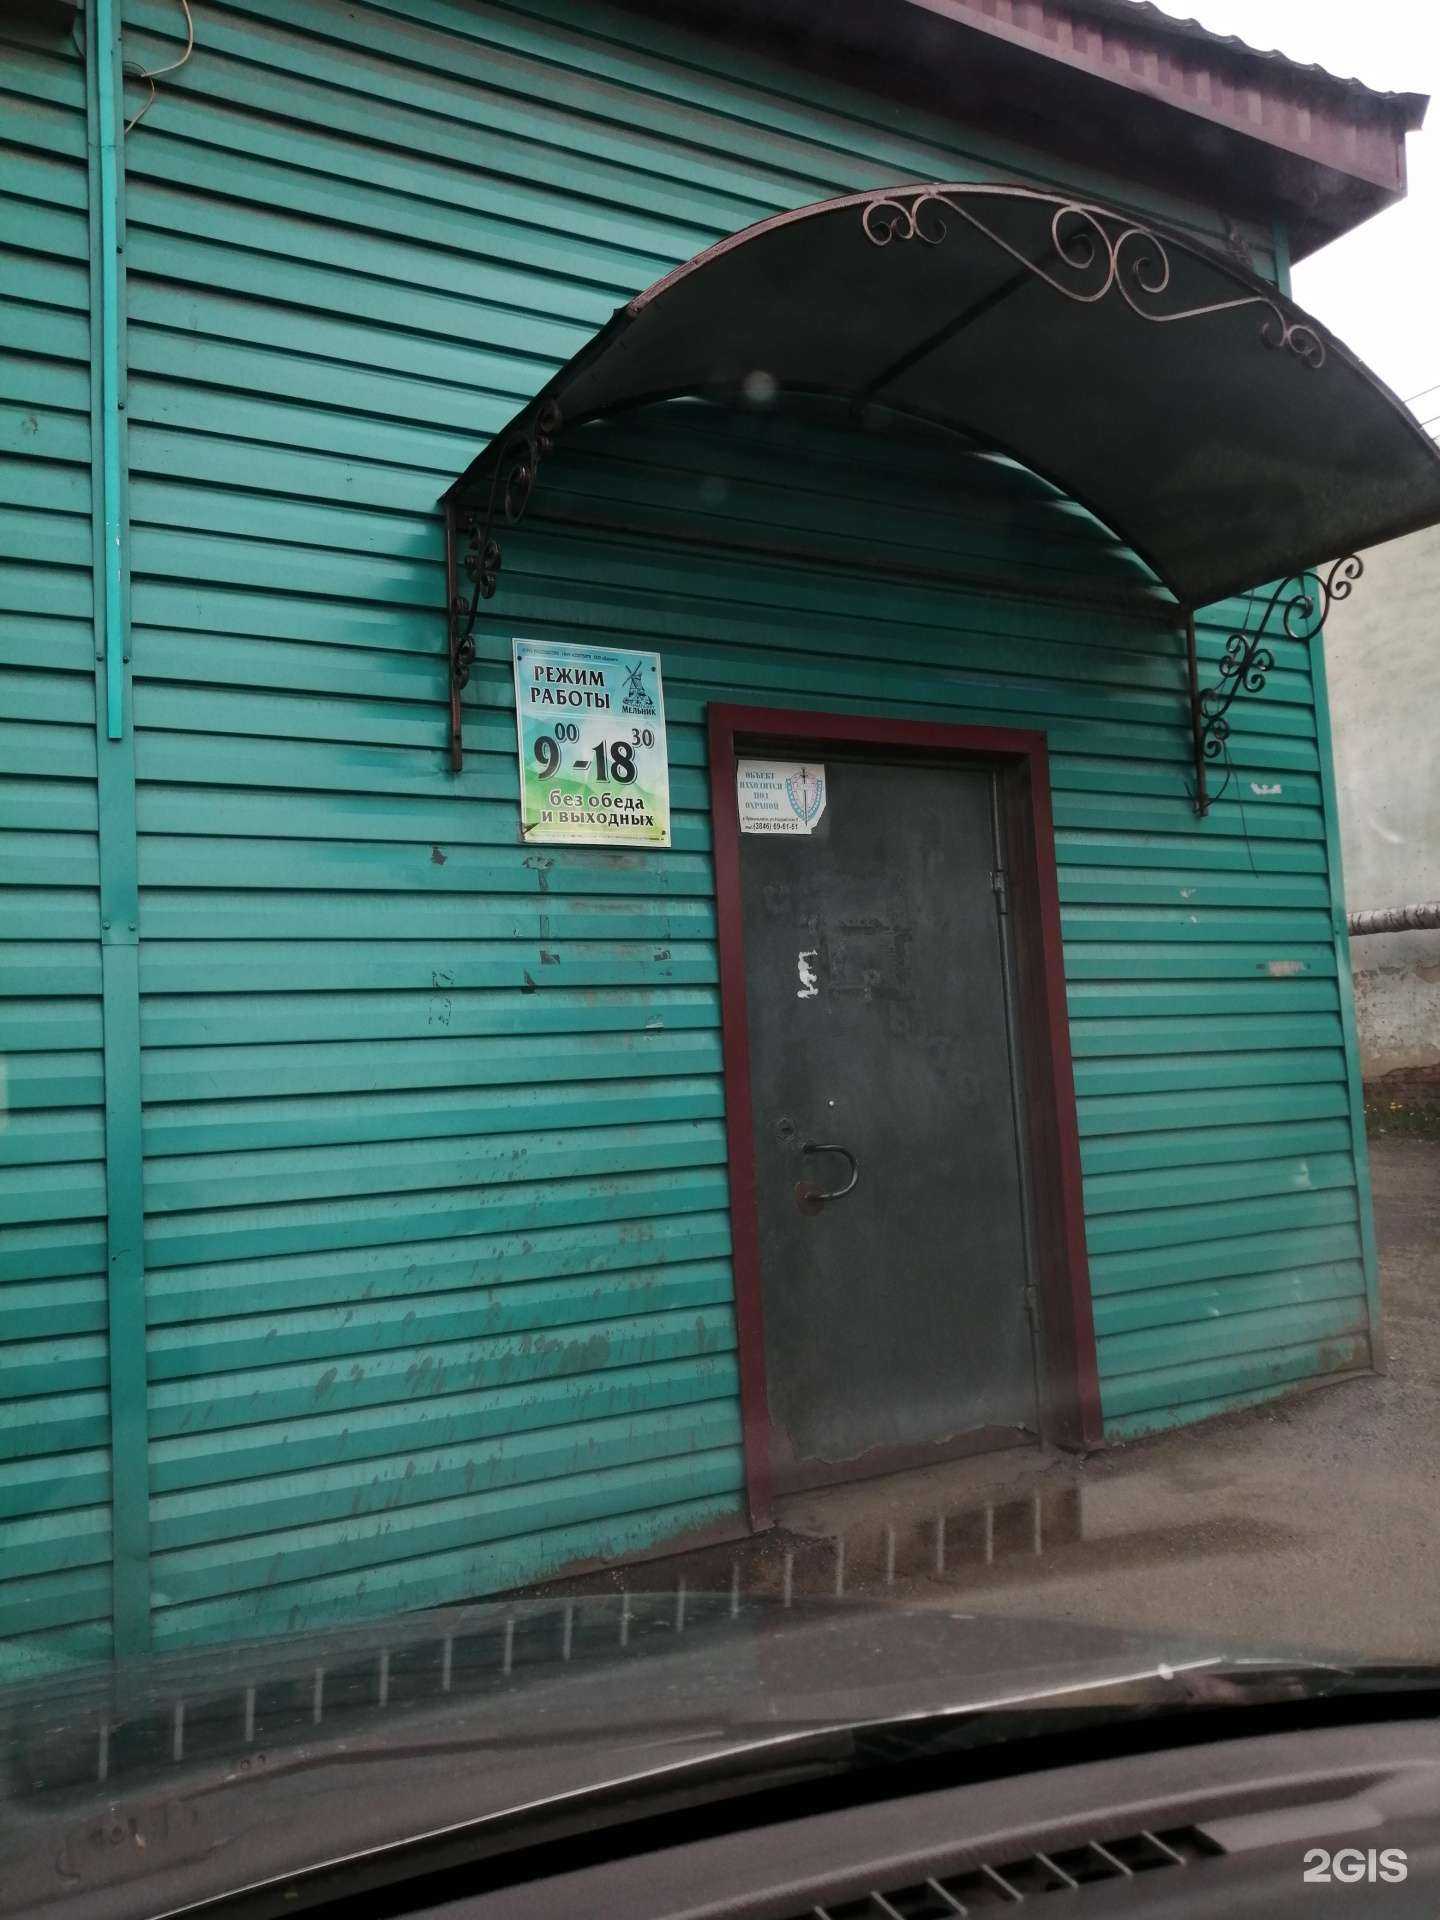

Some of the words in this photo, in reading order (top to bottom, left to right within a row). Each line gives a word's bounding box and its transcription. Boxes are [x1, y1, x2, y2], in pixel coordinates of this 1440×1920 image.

[534, 665, 605, 687] РЕЖИМ
[530, 687, 610, 709] РАБОТЫ
[550, 790, 584, 808] без
[588, 792, 645, 812] обеда
[542, 811, 553, 823] и
[559, 811, 654, 827] выходных
